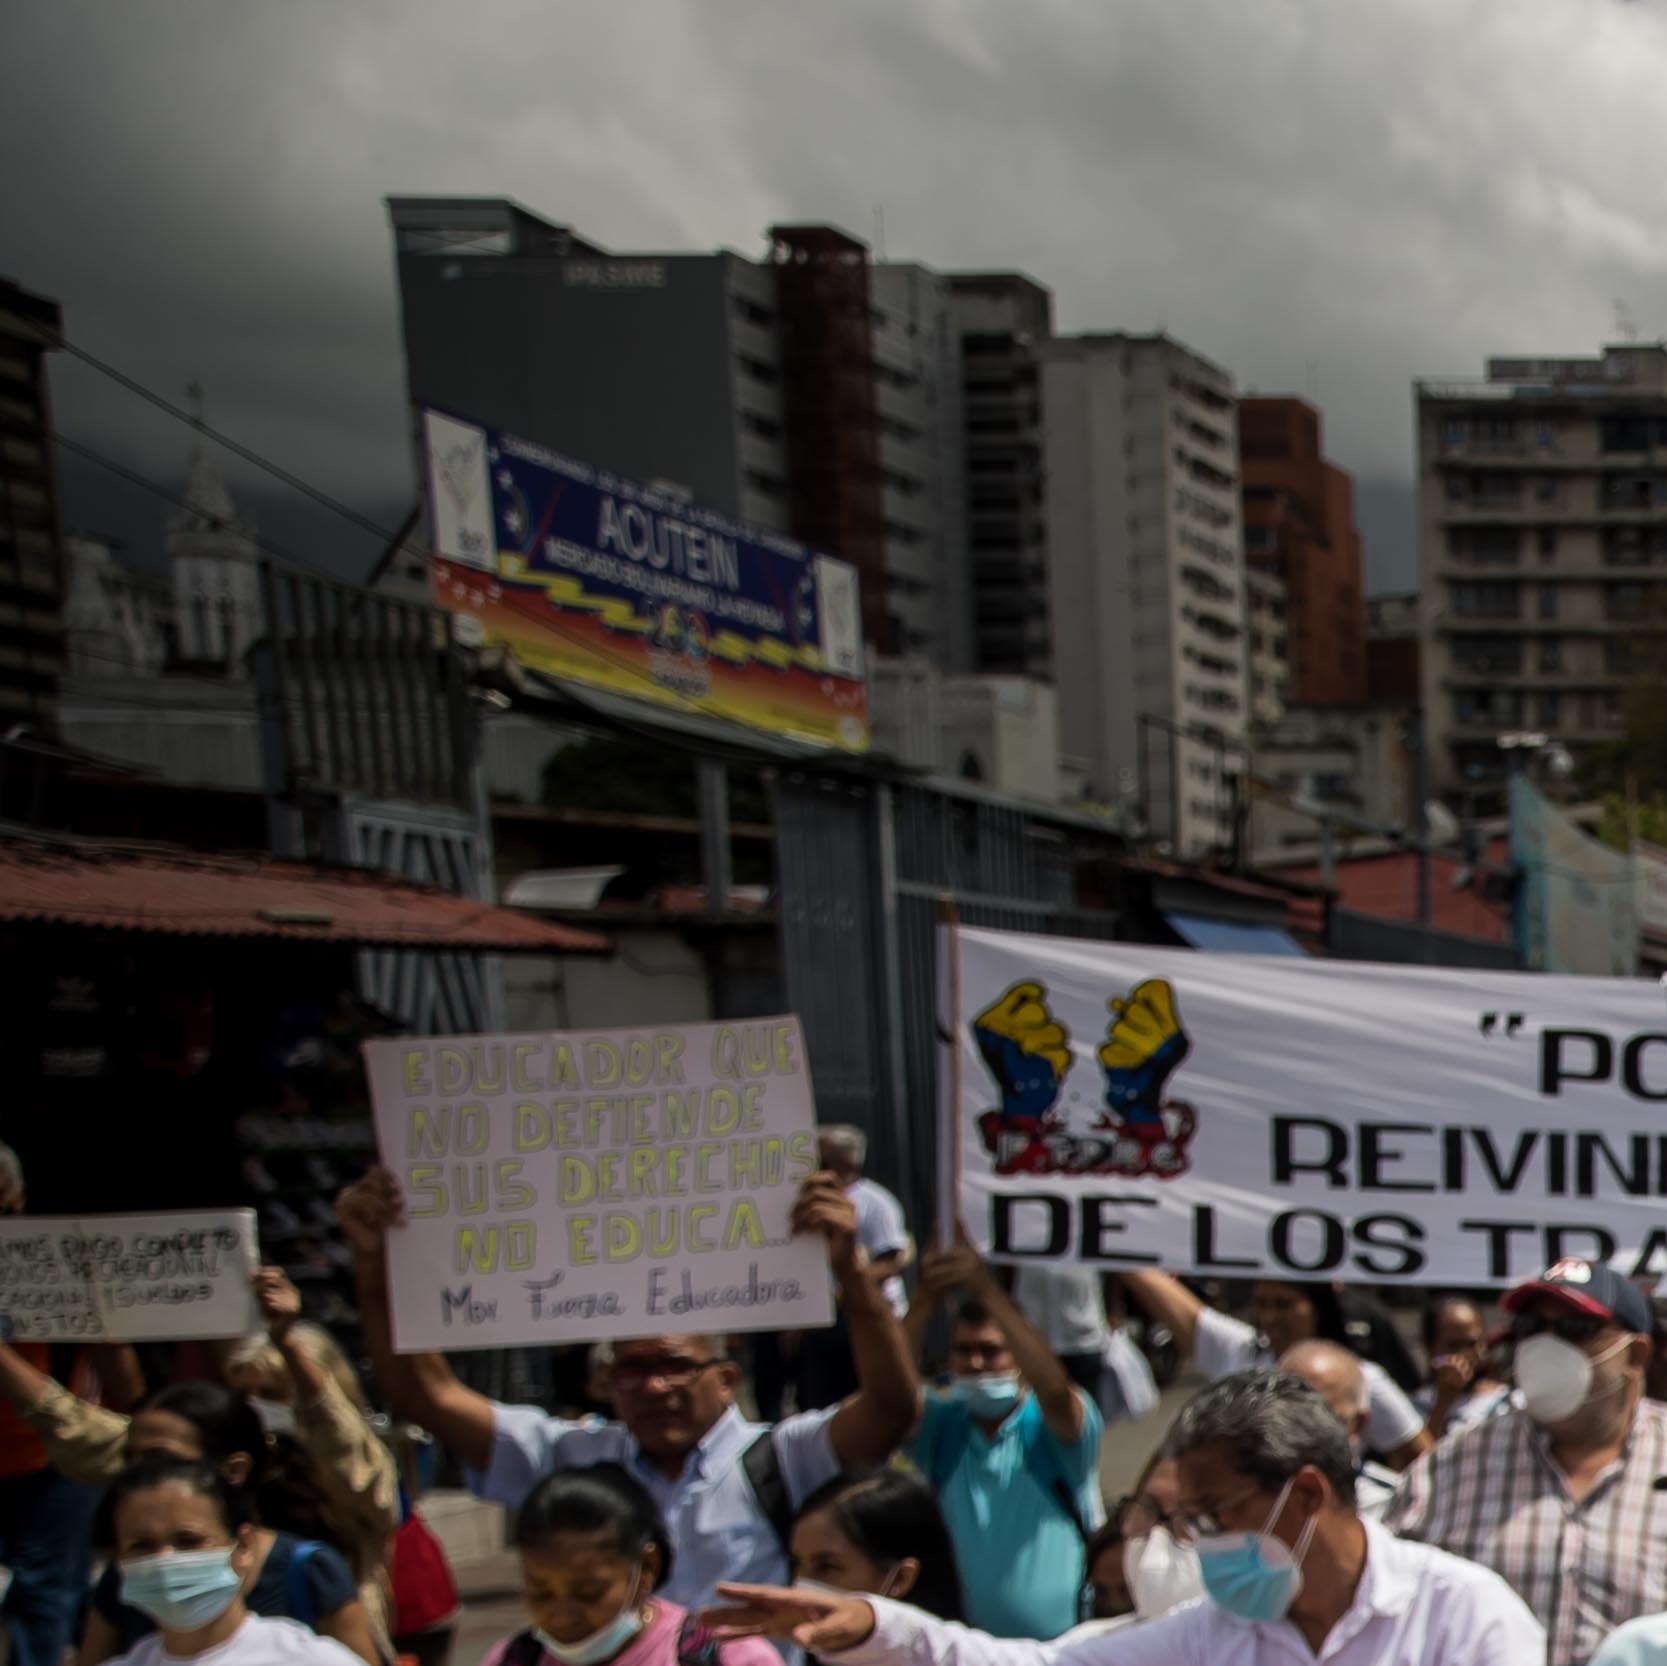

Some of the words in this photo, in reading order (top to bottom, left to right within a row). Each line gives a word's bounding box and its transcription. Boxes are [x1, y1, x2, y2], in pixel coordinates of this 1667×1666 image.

[597, 496, 739, 591] ACUTEIN
[402, 1031, 687, 1097] EDUCADOR
[711, 1024, 799, 1081] QUE
[407, 1101, 492, 1159] NO
[513, 1083, 767, 1154] DEFIENDE
[407, 1157, 538, 1219] SUS
[557, 1130, 819, 1208] DERECHOS
[454, 1221, 537, 1275] NO
[990, 1193, 1161, 1264] DE
[1195, 1205, 1425, 1277] LOS
